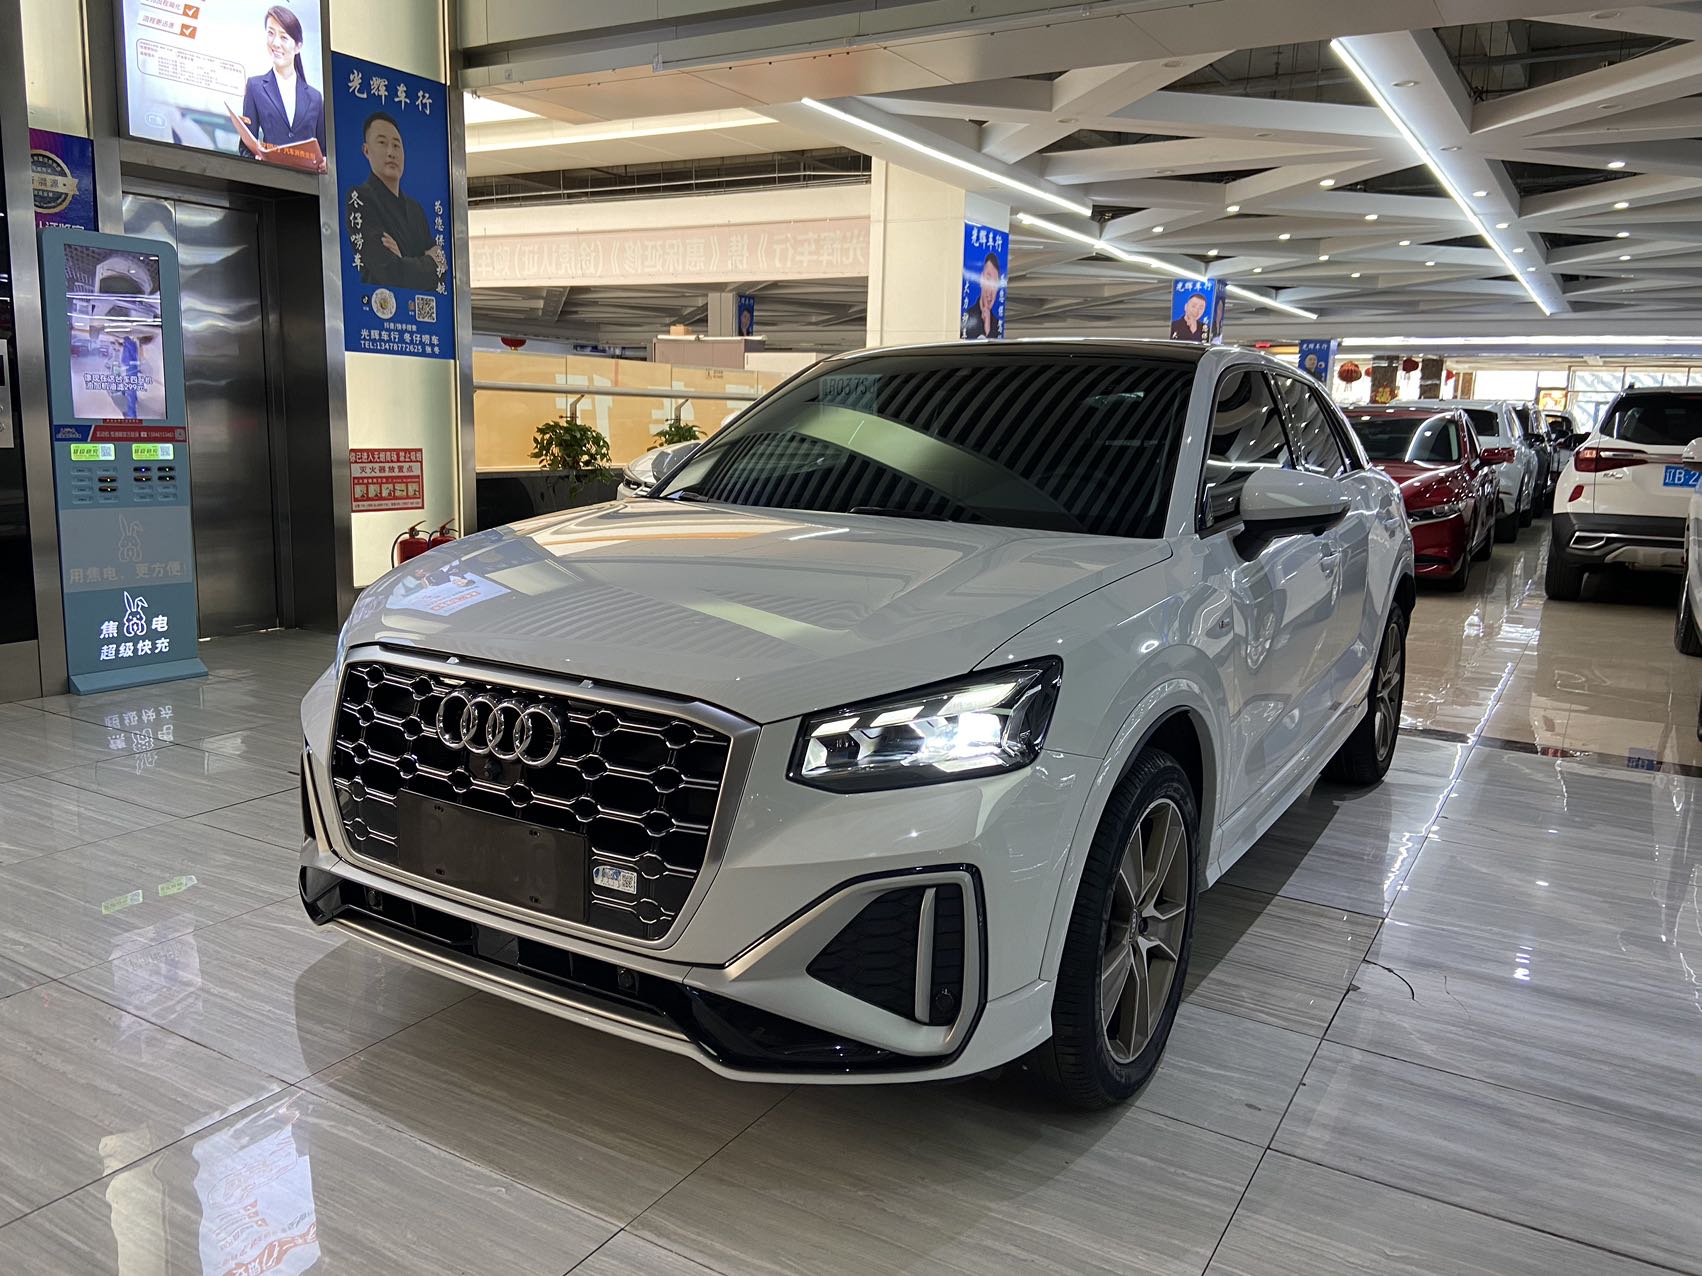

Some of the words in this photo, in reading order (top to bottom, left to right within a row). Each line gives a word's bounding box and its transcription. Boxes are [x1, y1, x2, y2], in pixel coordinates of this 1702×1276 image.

[348, 69, 432, 115] 光辉车行
[348, 190, 364, 271] 冬仔唠车
[971, 227, 1002, 252] 光辉车行
[360, 328, 400, 342] 光辉车行
[359, 465, 414, 474] 灭火器放置点
[99, 620, 118, 639] 焦
[151, 614, 168, 632] 电
[100, 637, 170, 660] 超级快充
